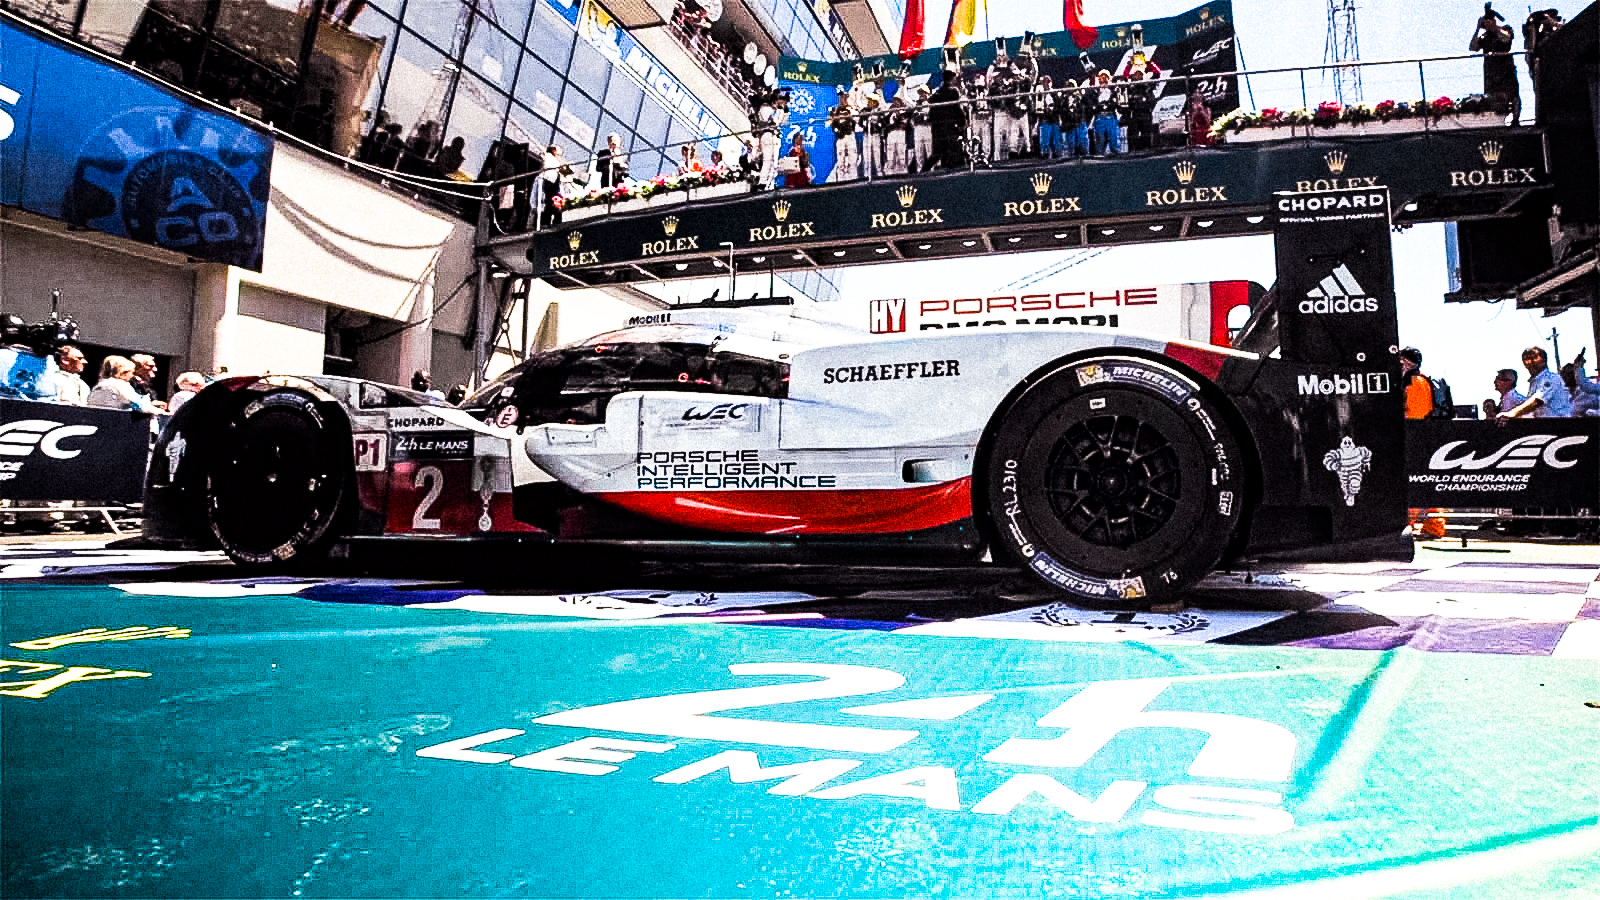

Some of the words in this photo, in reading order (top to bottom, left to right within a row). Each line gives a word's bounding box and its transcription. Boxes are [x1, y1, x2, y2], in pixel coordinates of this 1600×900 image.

[625, 45, 722, 140] MICHELIN
[1450, 168, 1536, 187] ROLEX
[1146, 186, 1228, 206] ROLEX
[1278, 194, 1384, 211] CHOPARD
[1004, 197, 1082, 216] ROLEX
[871, 209, 944, 228] ROLEX
[749, 222, 816, 242] ROLEX
[641, 236, 699, 256] ROLEX
[549, 250, 600, 270] ROLEX
[919, 288, 1158, 316] PORSCHE
[1298, 295, 1379, 314] adidas
[870, 299, 905, 333] HY
[823, 360, 961, 384] SCHAEFFLER
[1113, 366, 1187, 397] MICHELIN
[1297, 374, 1364, 395] Mobil
[387, 416, 445, 428] CHOPARD
[681, 403, 749, 421] WEC
[0, 419, 98, 460] EC
[419, 441, 434, 450] LE
[435, 440, 469, 451] MANS
[356, 439, 380, 466] P1
[637, 450, 760, 463] PORSCHE
[1428, 434, 1589, 470] WEC
[637, 463, 798, 476] INTELLIGENT
[1408, 474, 1449, 483] WORLD
[1452, 474, 1531, 483] ENDURANCE
[637, 476, 836, 489] PERFORMANCE
[1435, 483, 1528, 492] CHAMPIONSHIP
[413, 465, 444, 530] 2
[1034, 559, 1107, 596] MICHELIN
[415, 728, 677, 776] LE
[652, 750, 1295, 833] MANS
